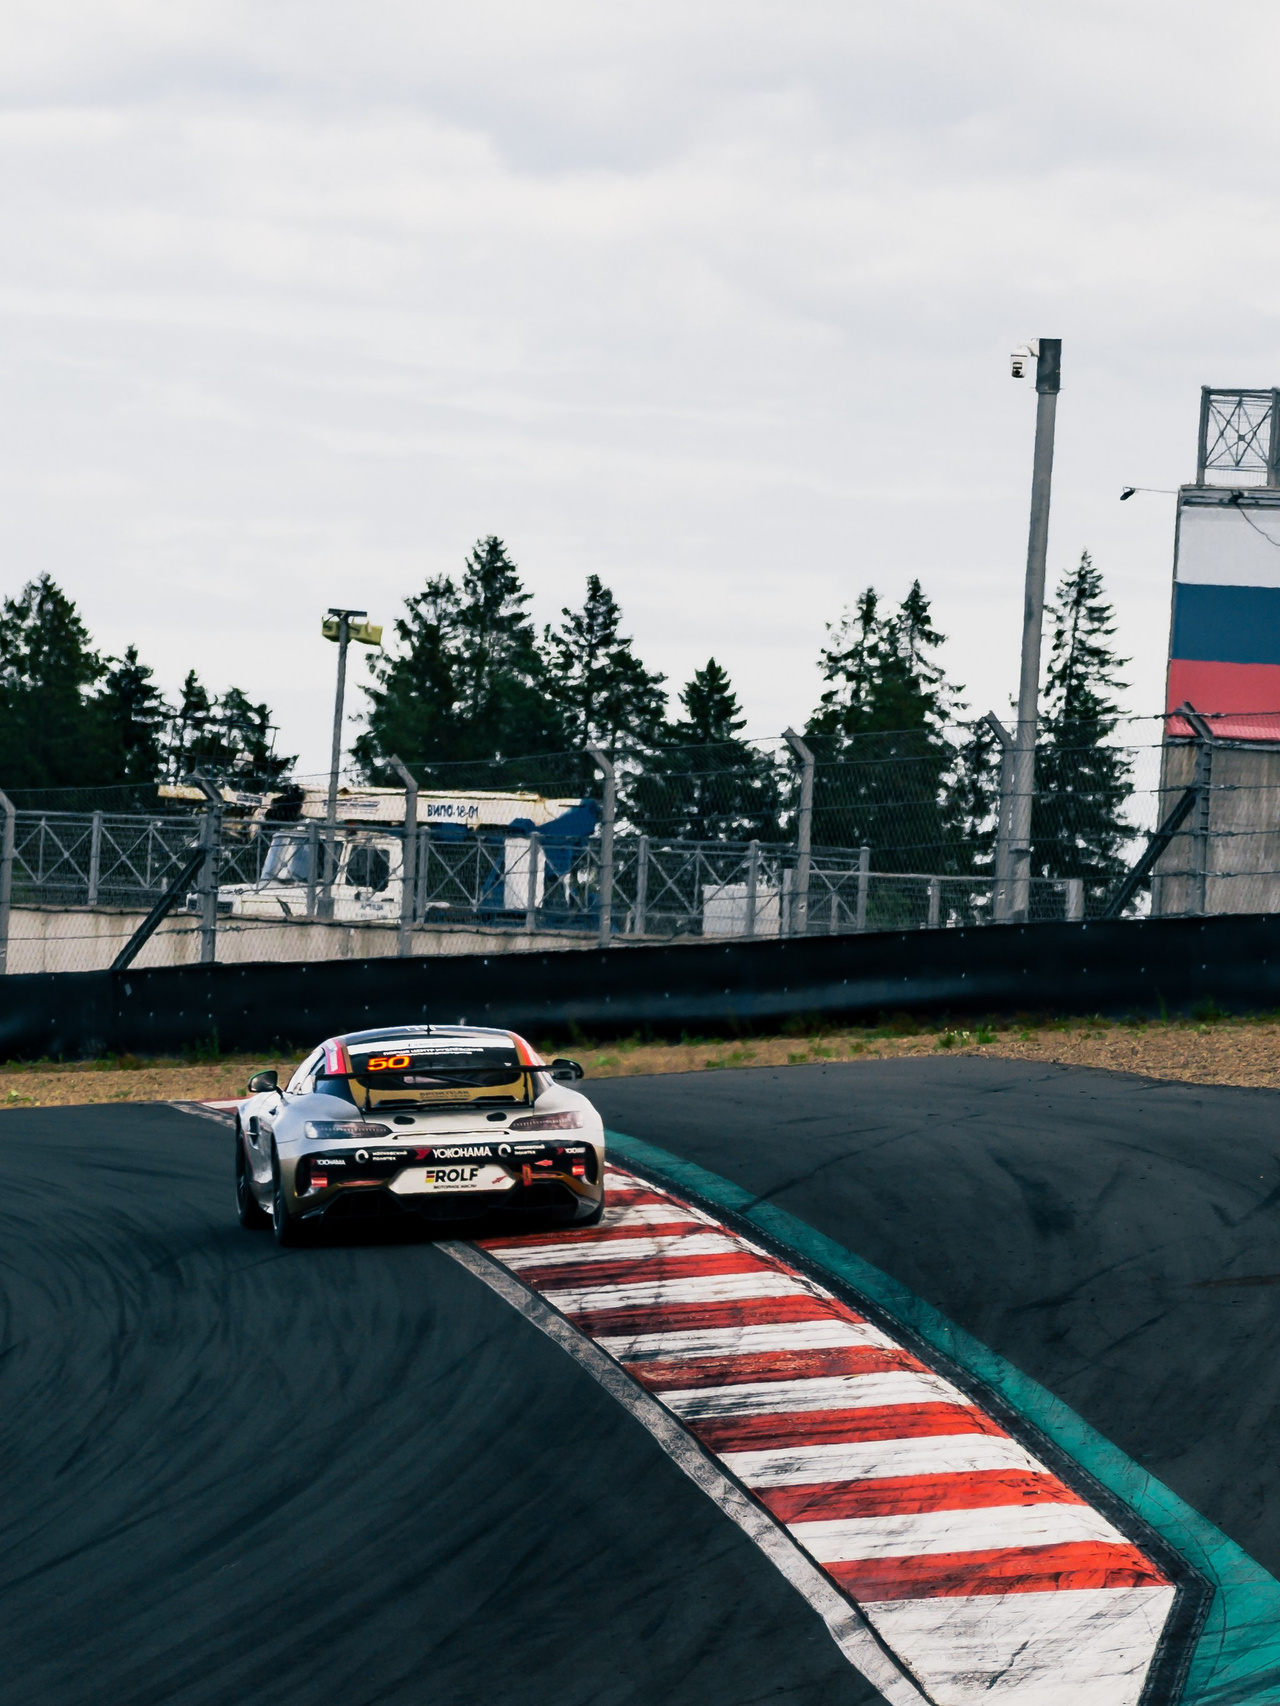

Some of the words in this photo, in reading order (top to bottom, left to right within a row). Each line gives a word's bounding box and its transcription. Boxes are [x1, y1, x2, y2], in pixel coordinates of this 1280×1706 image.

[367, 1055, 410, 1071] 50
[432, 1146, 493, 1158] YOKOHAMA
[435, 1168, 479, 1183] ROLF
